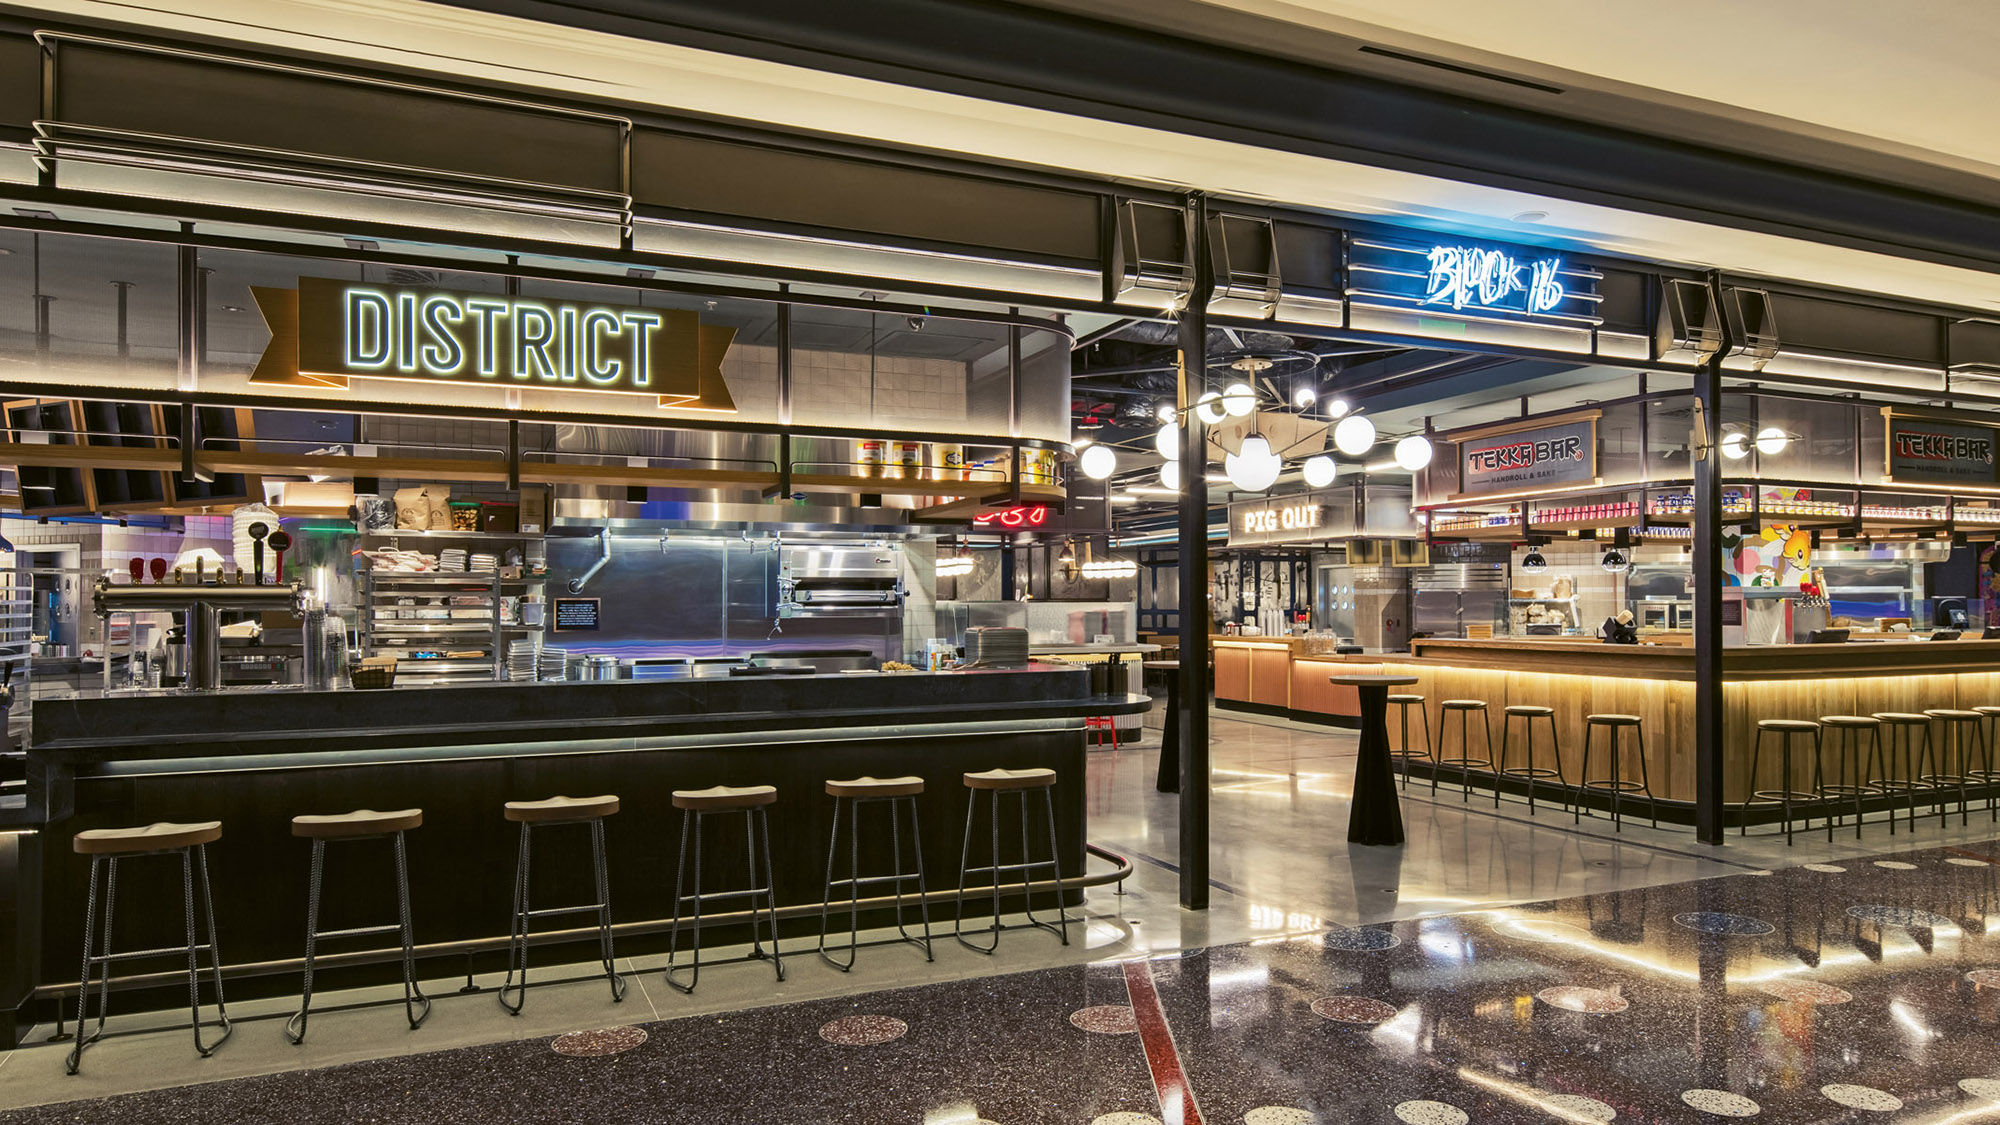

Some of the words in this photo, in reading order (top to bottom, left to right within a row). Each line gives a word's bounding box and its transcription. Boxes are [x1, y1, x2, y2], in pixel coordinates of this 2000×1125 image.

[1528, 257, 1564, 316] 16
[344, 288, 663, 386] DISTRICT
[1469, 444, 1533, 471] TEKKA
[1535, 436, 1581, 463] BAR
[1896, 432, 1954, 460] TEKKA
[1955, 437, 1991, 462] BAR
[1491, 474, 1528, 484] HANDROLL
[1244, 509, 1278, 533] PIG
[1281, 504, 1319, 530] OUT
